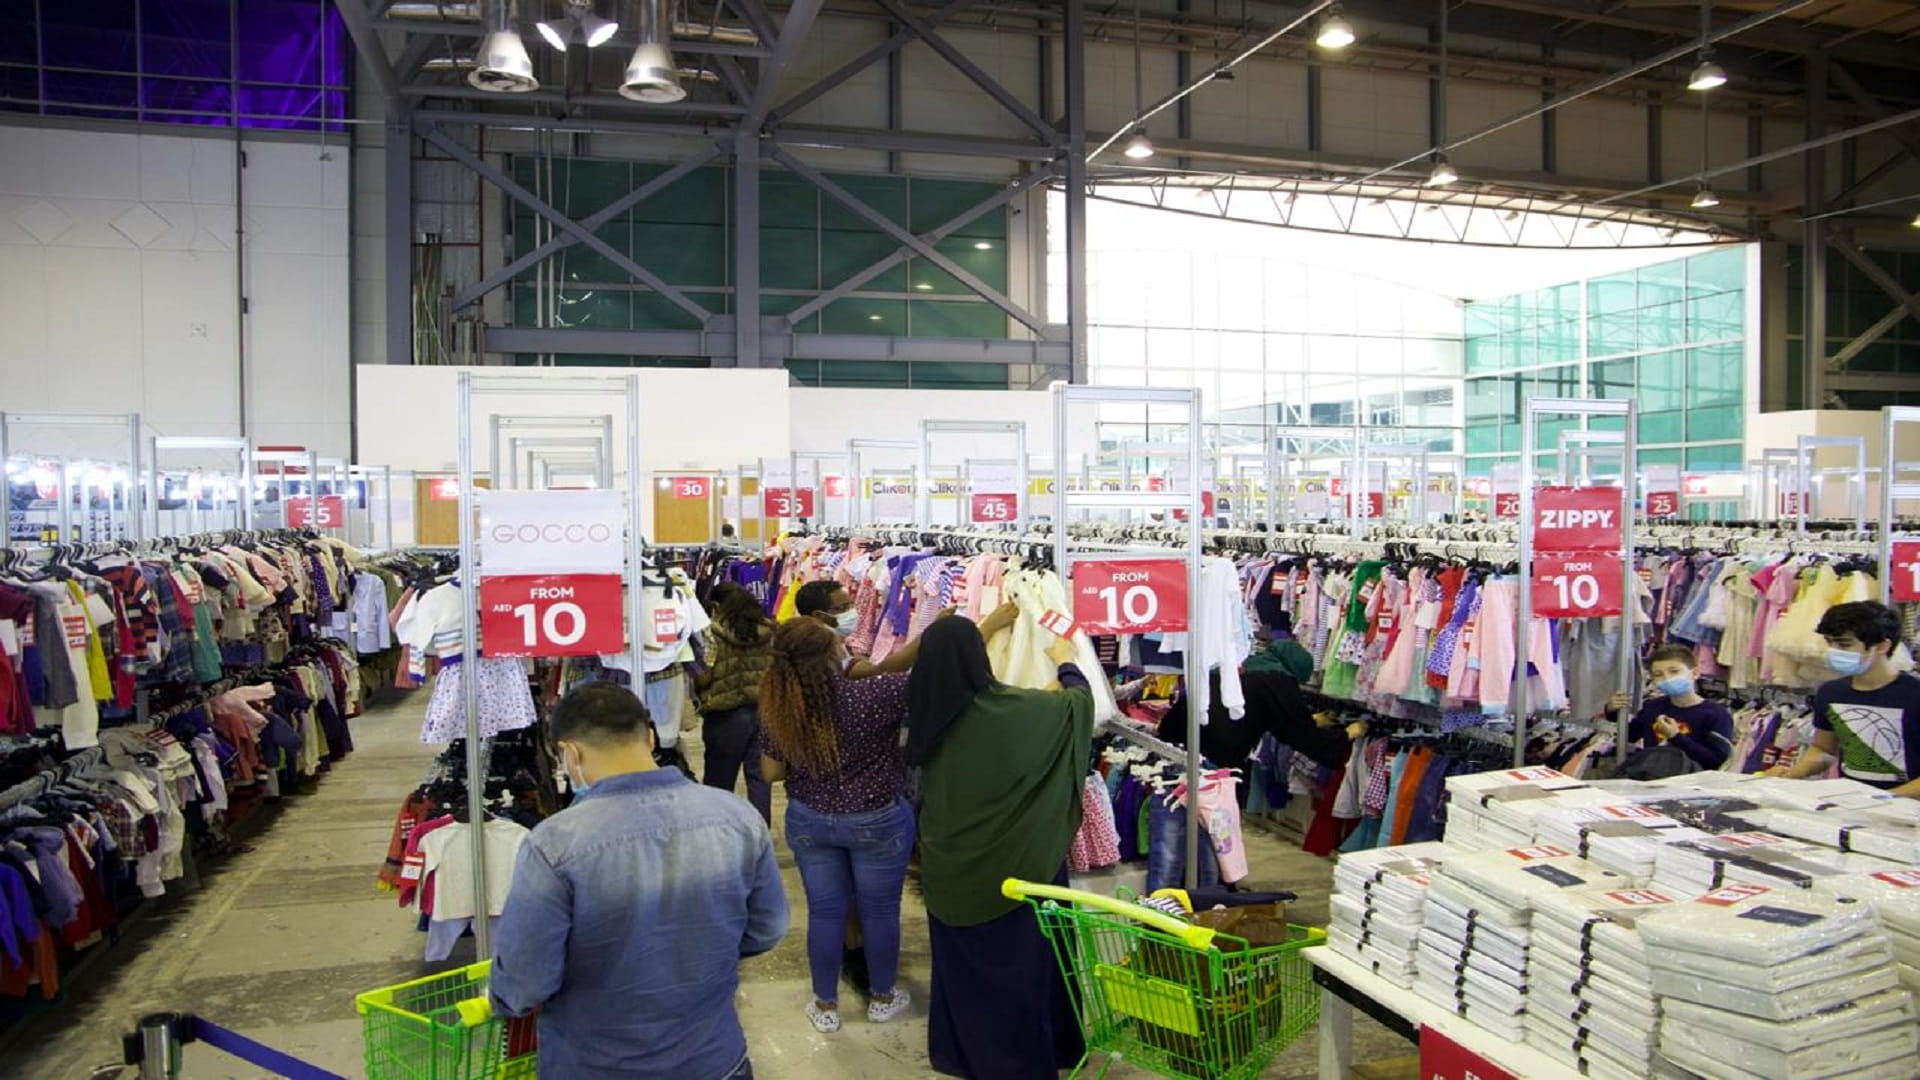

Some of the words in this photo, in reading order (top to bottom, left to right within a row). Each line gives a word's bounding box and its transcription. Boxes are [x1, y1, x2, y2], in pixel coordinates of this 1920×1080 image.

[682, 484, 703, 496] 30
[981, 502, 1008, 519] 45
[1653, 499, 1672, 513] 25
[301, 507, 332, 524] 35
[491, 523, 611, 544] GOCCO
[1563, 562, 1593, 572] FROM
[1112, 573, 1149, 583] FROM
[529, 586, 575, 600] FROM
[1552, 574, 1600, 609] 10
[1099, 585, 1158, 629] 10
[513, 602, 587, 647] 10
